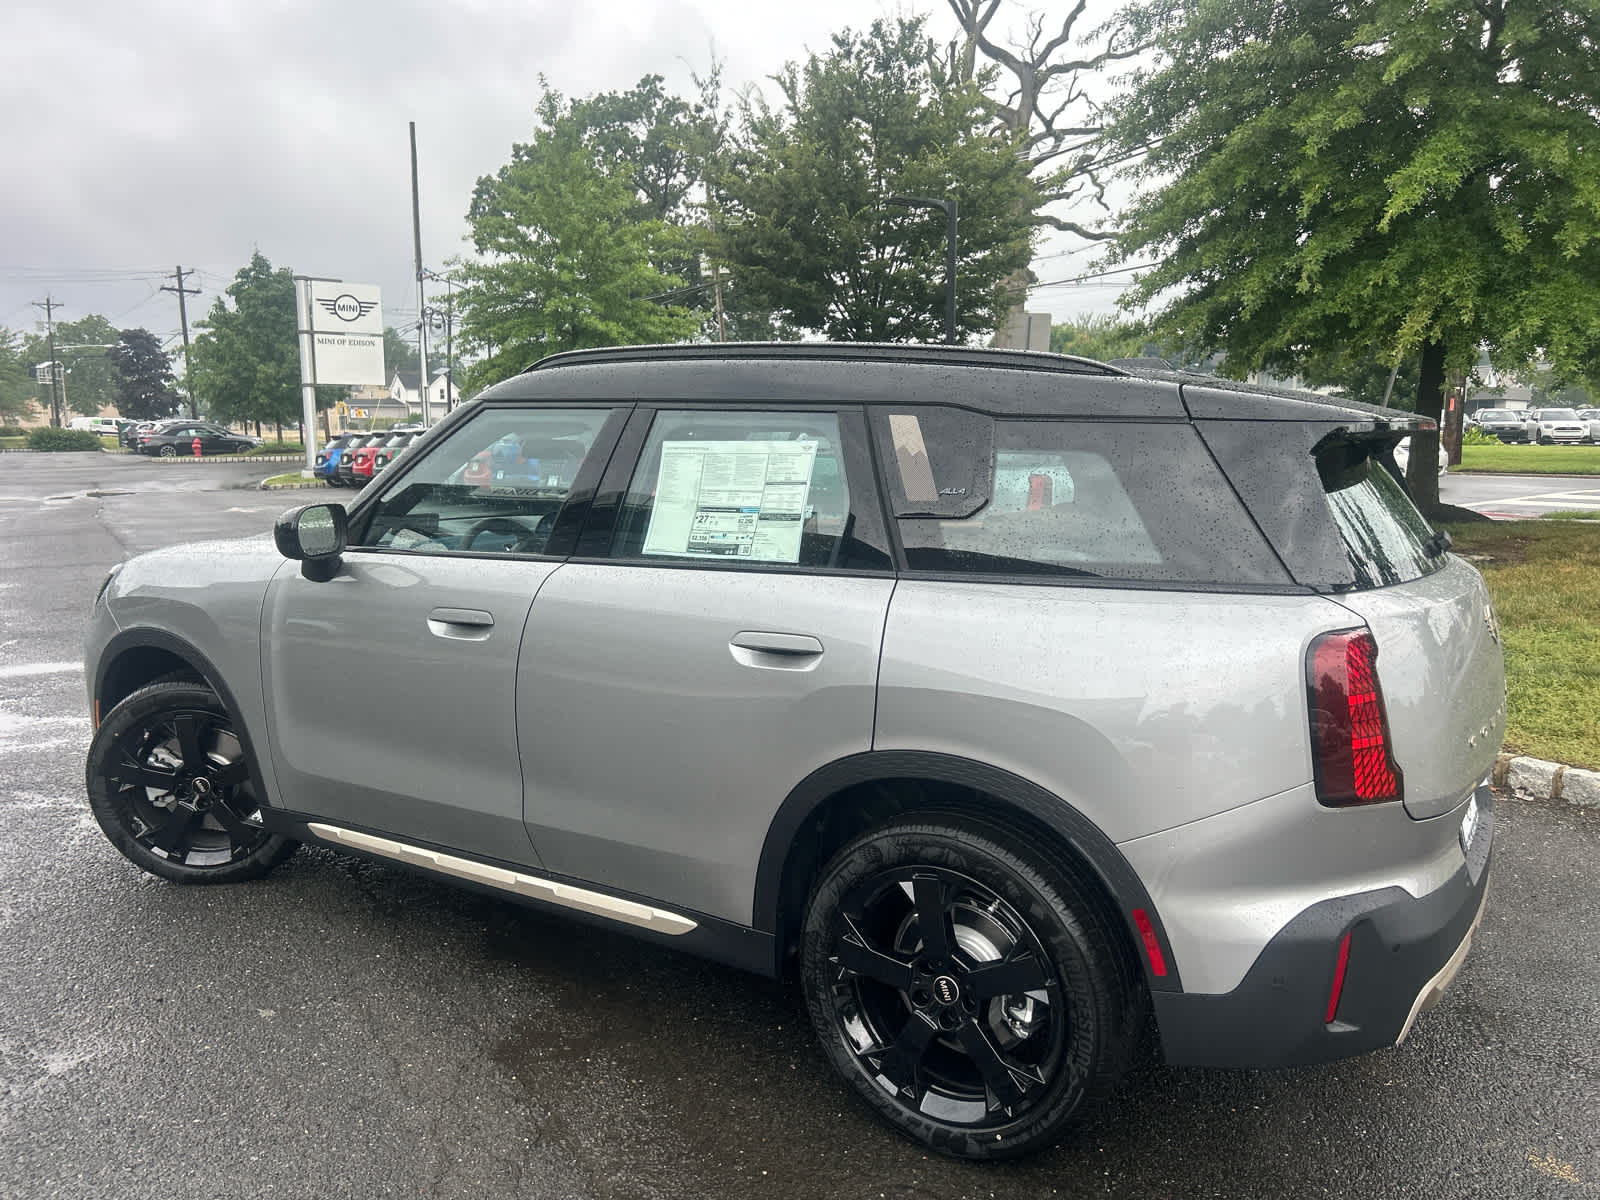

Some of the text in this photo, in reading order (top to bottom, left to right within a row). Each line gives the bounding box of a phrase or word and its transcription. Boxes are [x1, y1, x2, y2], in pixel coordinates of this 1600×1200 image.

[337, 304, 358, 313] MINI
[317, 337, 335, 345] MINI
[938, 487, 966, 495] ALL4
[939, 980, 952, 1001] MINI
